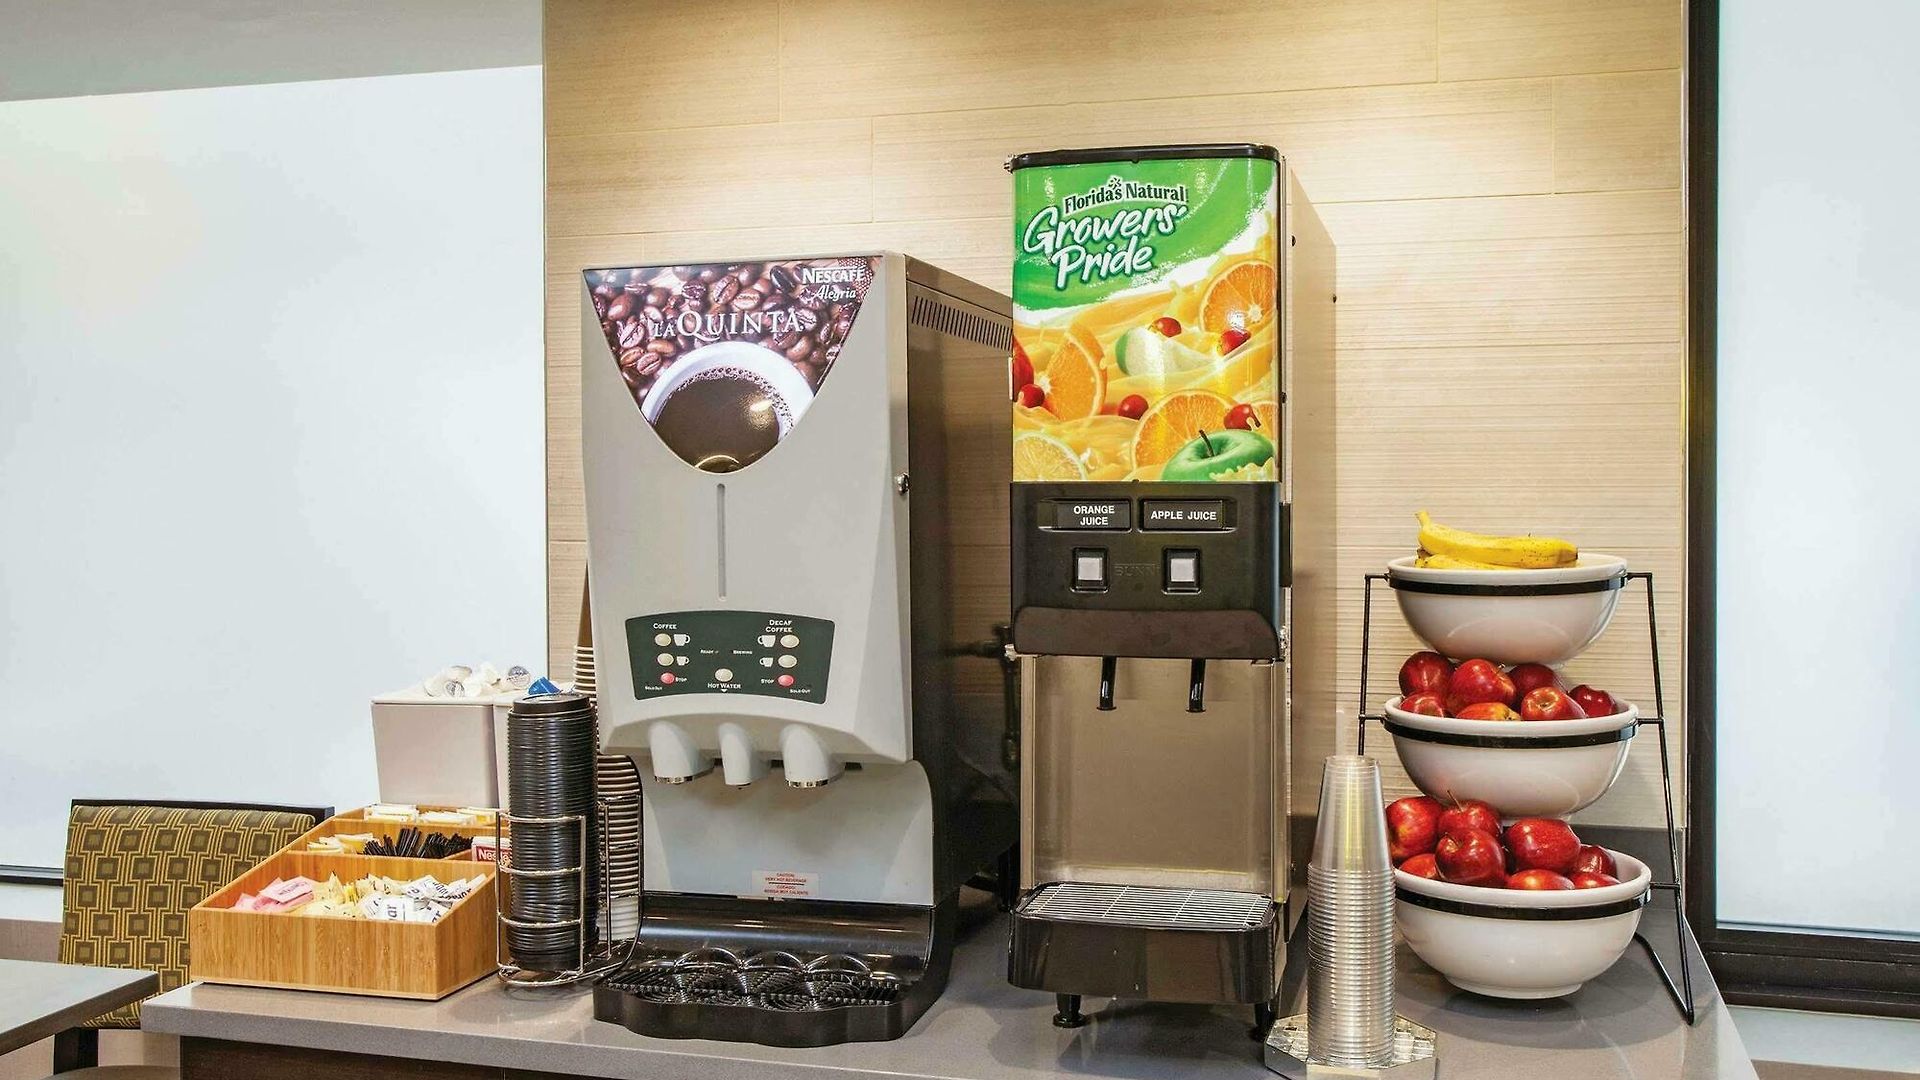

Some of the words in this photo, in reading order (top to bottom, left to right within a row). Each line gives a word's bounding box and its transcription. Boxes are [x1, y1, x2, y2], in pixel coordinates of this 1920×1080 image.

[1051, 235, 1153, 289] Pride
[677, 308, 803, 342] QUINTA
[1073, 505, 1115, 515] ORANGE
[1150, 510, 1183, 520] APPLE
[1187, 511, 1217, 520] JUICE
[1079, 516, 1109, 526] JUICE
